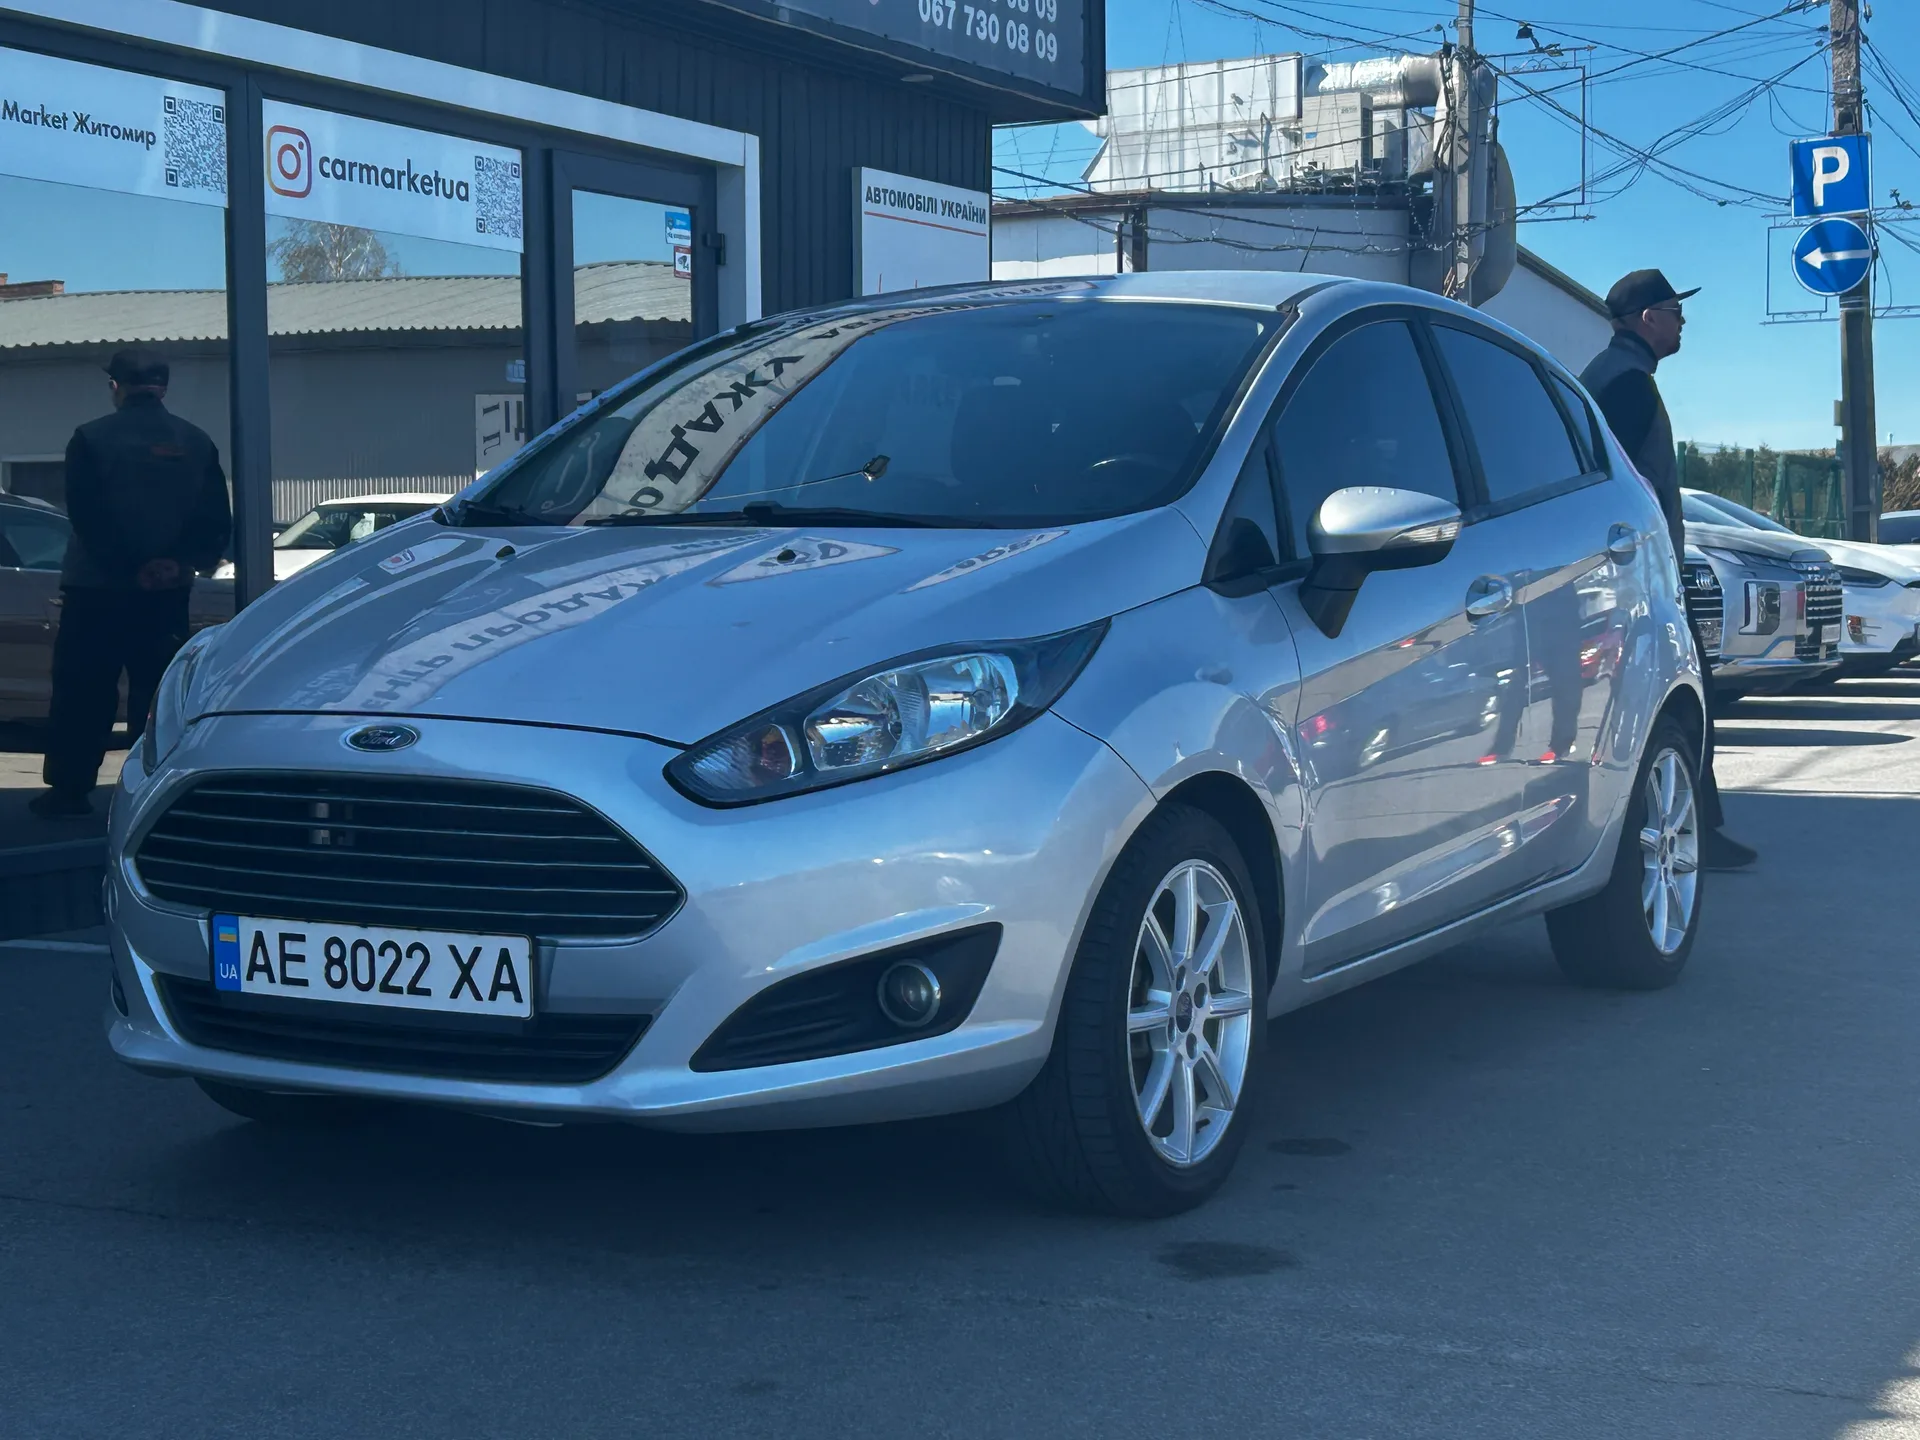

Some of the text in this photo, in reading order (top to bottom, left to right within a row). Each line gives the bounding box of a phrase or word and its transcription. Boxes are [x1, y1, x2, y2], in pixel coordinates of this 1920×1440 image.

[918, 0, 1058, 62] 067 730 08 09
[1, 99, 157, 151] Market Житомир
[318, 155, 470, 203] carmarketua
[1812, 146, 1850, 207] P
[865, 185, 987, 225] АВТОМОБІЛІ УКРАЇНИ
[220, 962, 238, 980] UA
[246, 930, 524, 1003] AE 8022 XA
